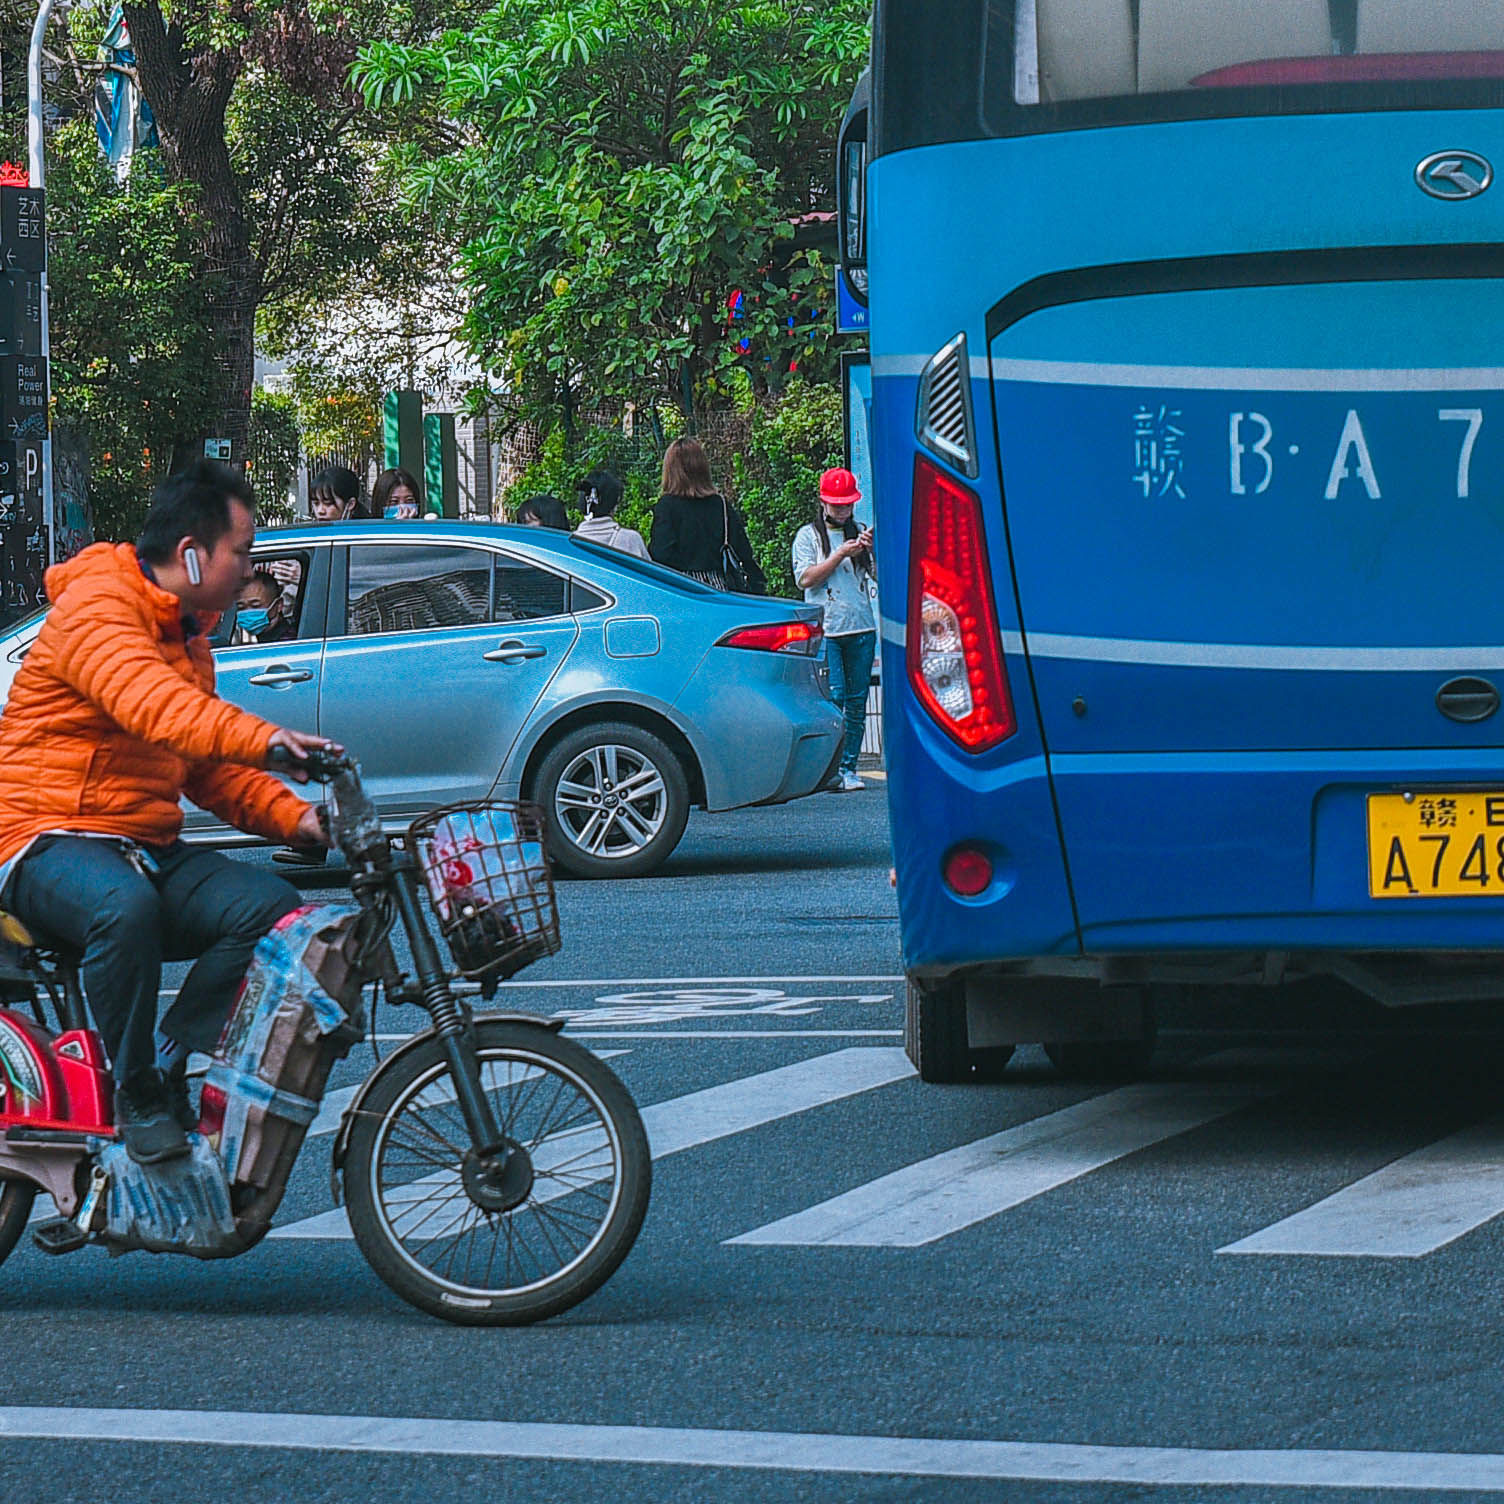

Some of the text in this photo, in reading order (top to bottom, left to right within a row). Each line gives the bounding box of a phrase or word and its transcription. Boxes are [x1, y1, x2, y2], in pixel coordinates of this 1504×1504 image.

[18, 197, 40, 216] 艺术
[18, 217, 40, 239] 西区
[18, 363, 37, 378] Real
[18, 377, 44, 393] Power
